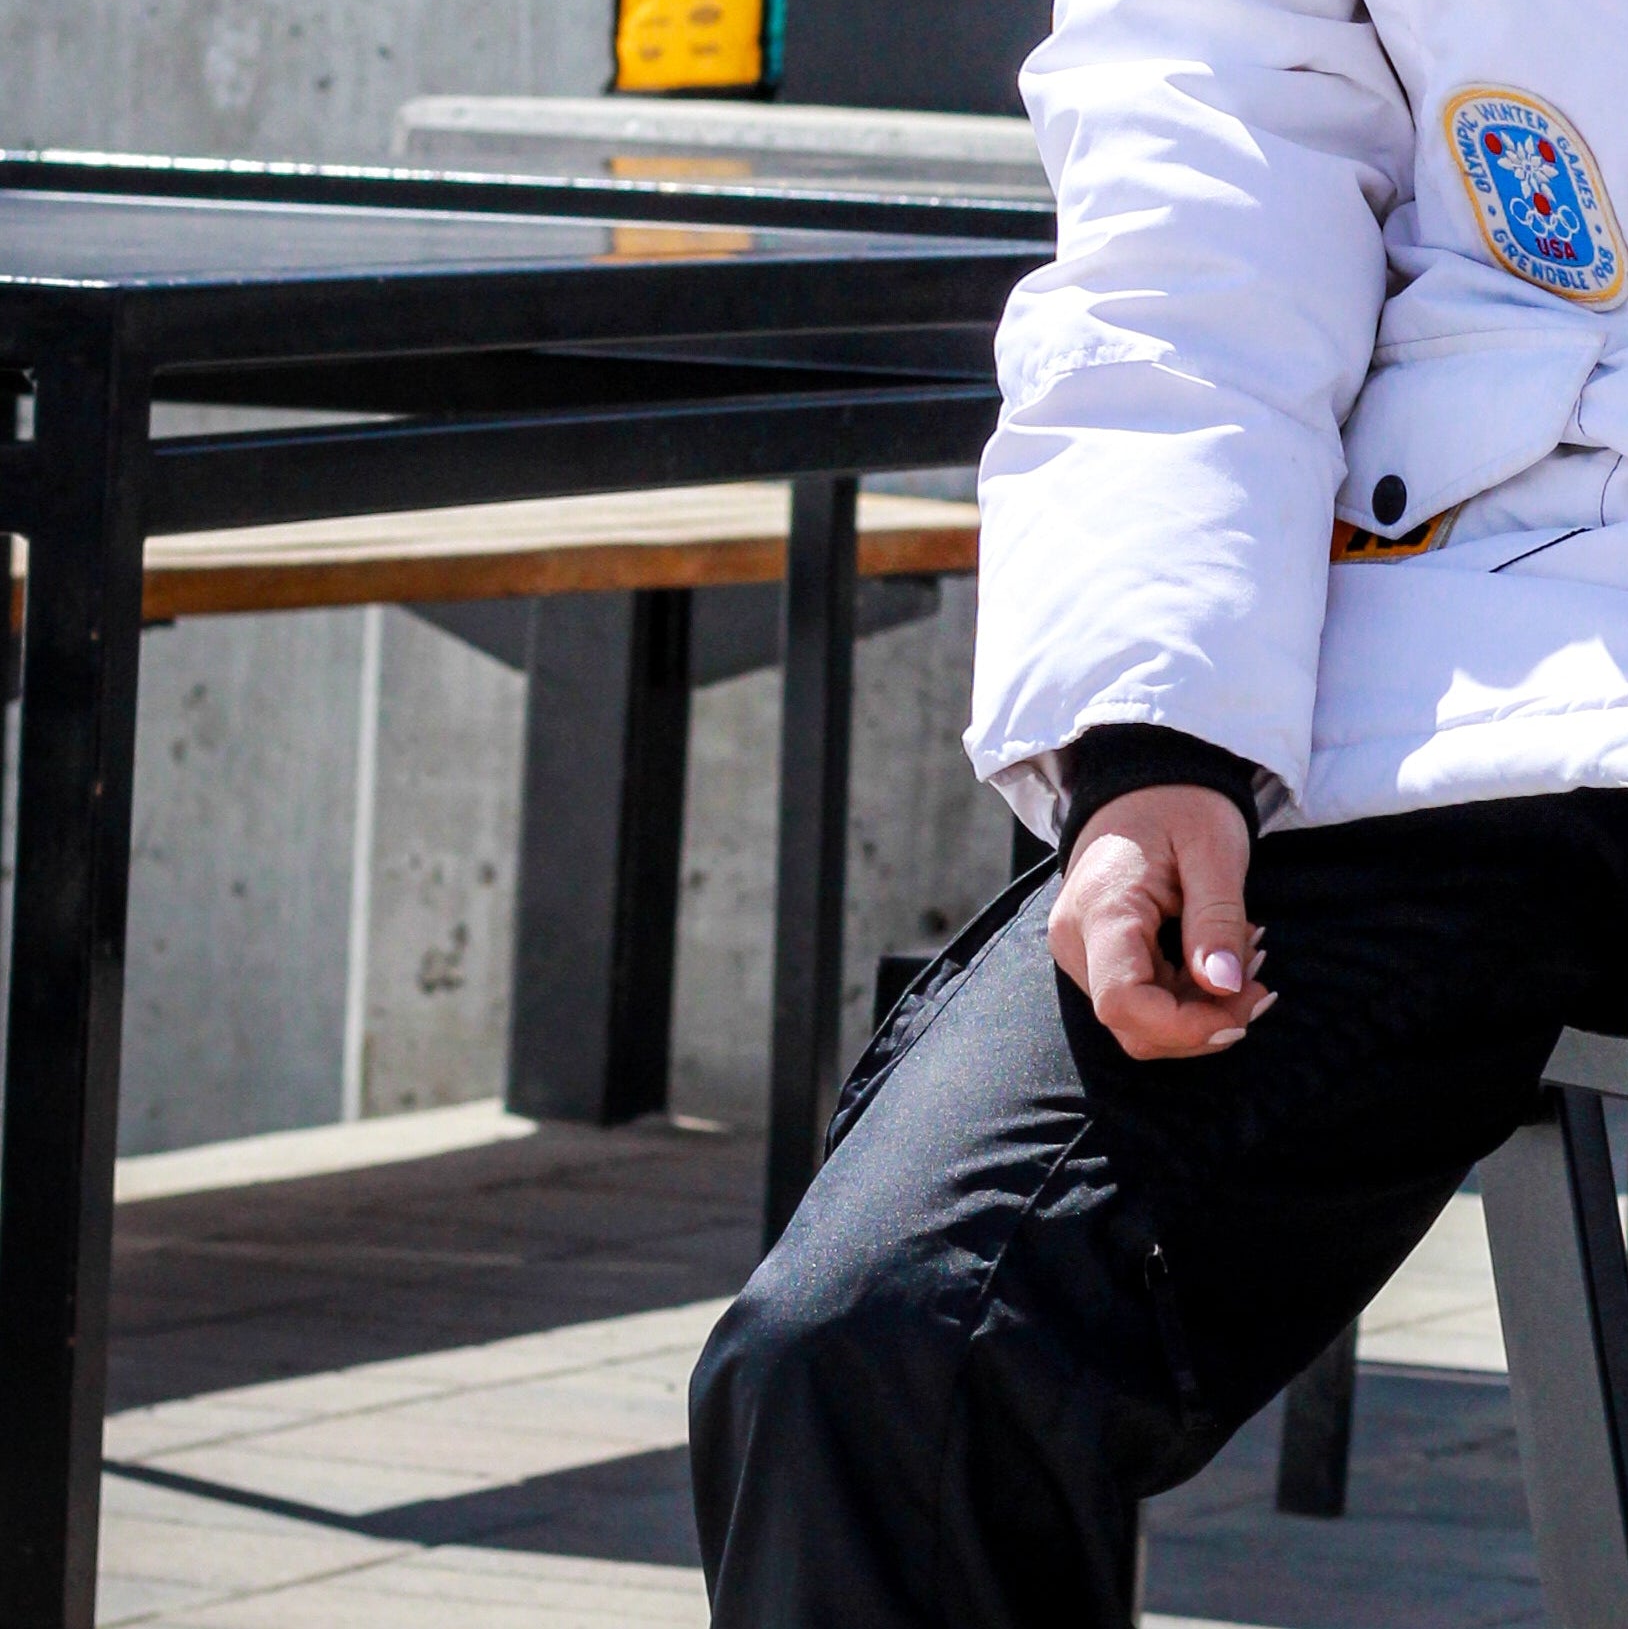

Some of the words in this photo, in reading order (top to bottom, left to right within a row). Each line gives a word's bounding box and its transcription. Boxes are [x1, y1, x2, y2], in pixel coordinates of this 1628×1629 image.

[1473, 103, 1549, 134] WINTER
[1457, 110, 1492, 194] OLYMPIC
[1556, 135, 1598, 212] GAMES
[1492, 229, 1590, 291] GRENOBLE
[1592, 245, 1614, 289] 1968
[1535, 237, 1578, 261] USA
